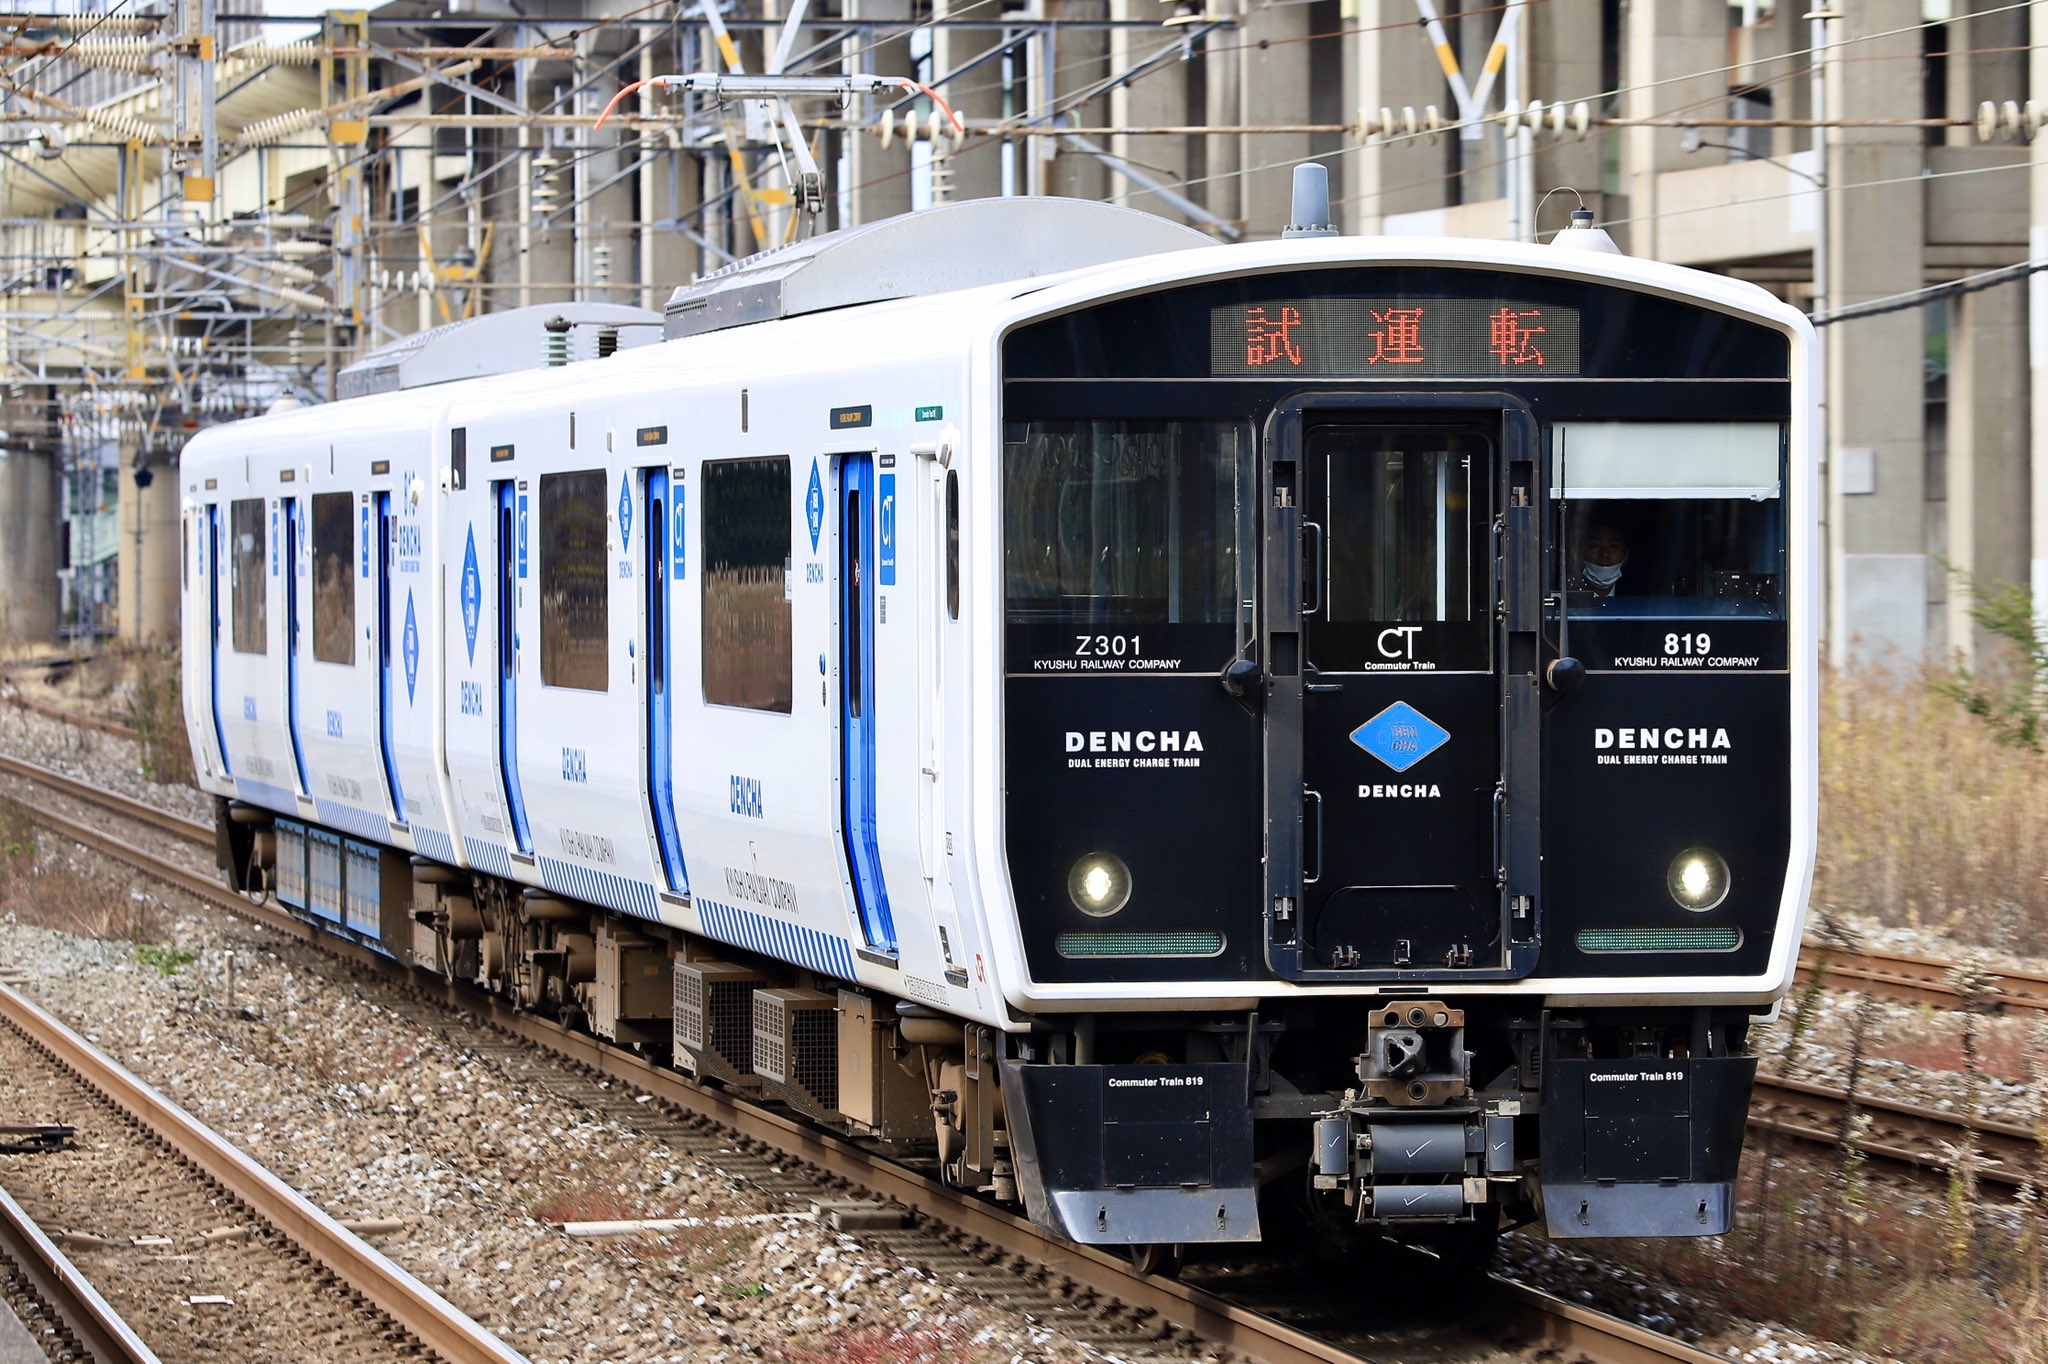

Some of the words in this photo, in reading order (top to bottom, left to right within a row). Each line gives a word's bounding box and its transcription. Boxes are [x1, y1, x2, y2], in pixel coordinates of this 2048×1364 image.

[1245, 306, 1547, 366] 試運転
[1075, 635, 1140, 656] Z301
[1377, 626, 1423, 660] CT
[1664, 632, 1711, 655] 819
[1034, 659, 1078, 670] KYUSHU
[1080, 659, 1126, 670] RAILWAY
[1128, 659, 1182, 669] COMPANY
[1364, 661, 1412, 671] Commuter
[1412, 661, 1436, 671] Train
[1614, 656, 1658, 667] KYUSHU
[1660, 656, 1705, 667] RAILWAY
[1707, 656, 1760, 667] COMPANY
[461, 681, 482, 716] DENCHA
[1065, 730, 1204, 753] DENCHA
[1594, 727, 1732, 750] DENCHA
[562, 747, 587, 784] DENCHA
[1068, 758, 1093, 768] DUAL
[1094, 758, 1131, 768] ENERGY
[1133, 758, 1170, 768] CHARGE
[1172, 758, 1200, 768] TRAIN
[1597, 755, 1622, 765] DUAL
[1623, 755, 1659, 765] ENERGY
[1661, 755, 1698, 765] CHARGE
[1699, 755, 1728, 765] TRAIN
[730, 774, 764, 820] DENCHA
[1359, 784, 1441, 798] DENCHA
[1108, 1078, 1158, 1088] Commuter
[1159, 1077, 1184, 1087] Train
[1185, 1076, 1204, 1086] 819
[1589, 1072, 1639, 1082] Commuter
[1640, 1072, 1664, 1081] Train
[1665, 1071, 1684, 1081] 819
